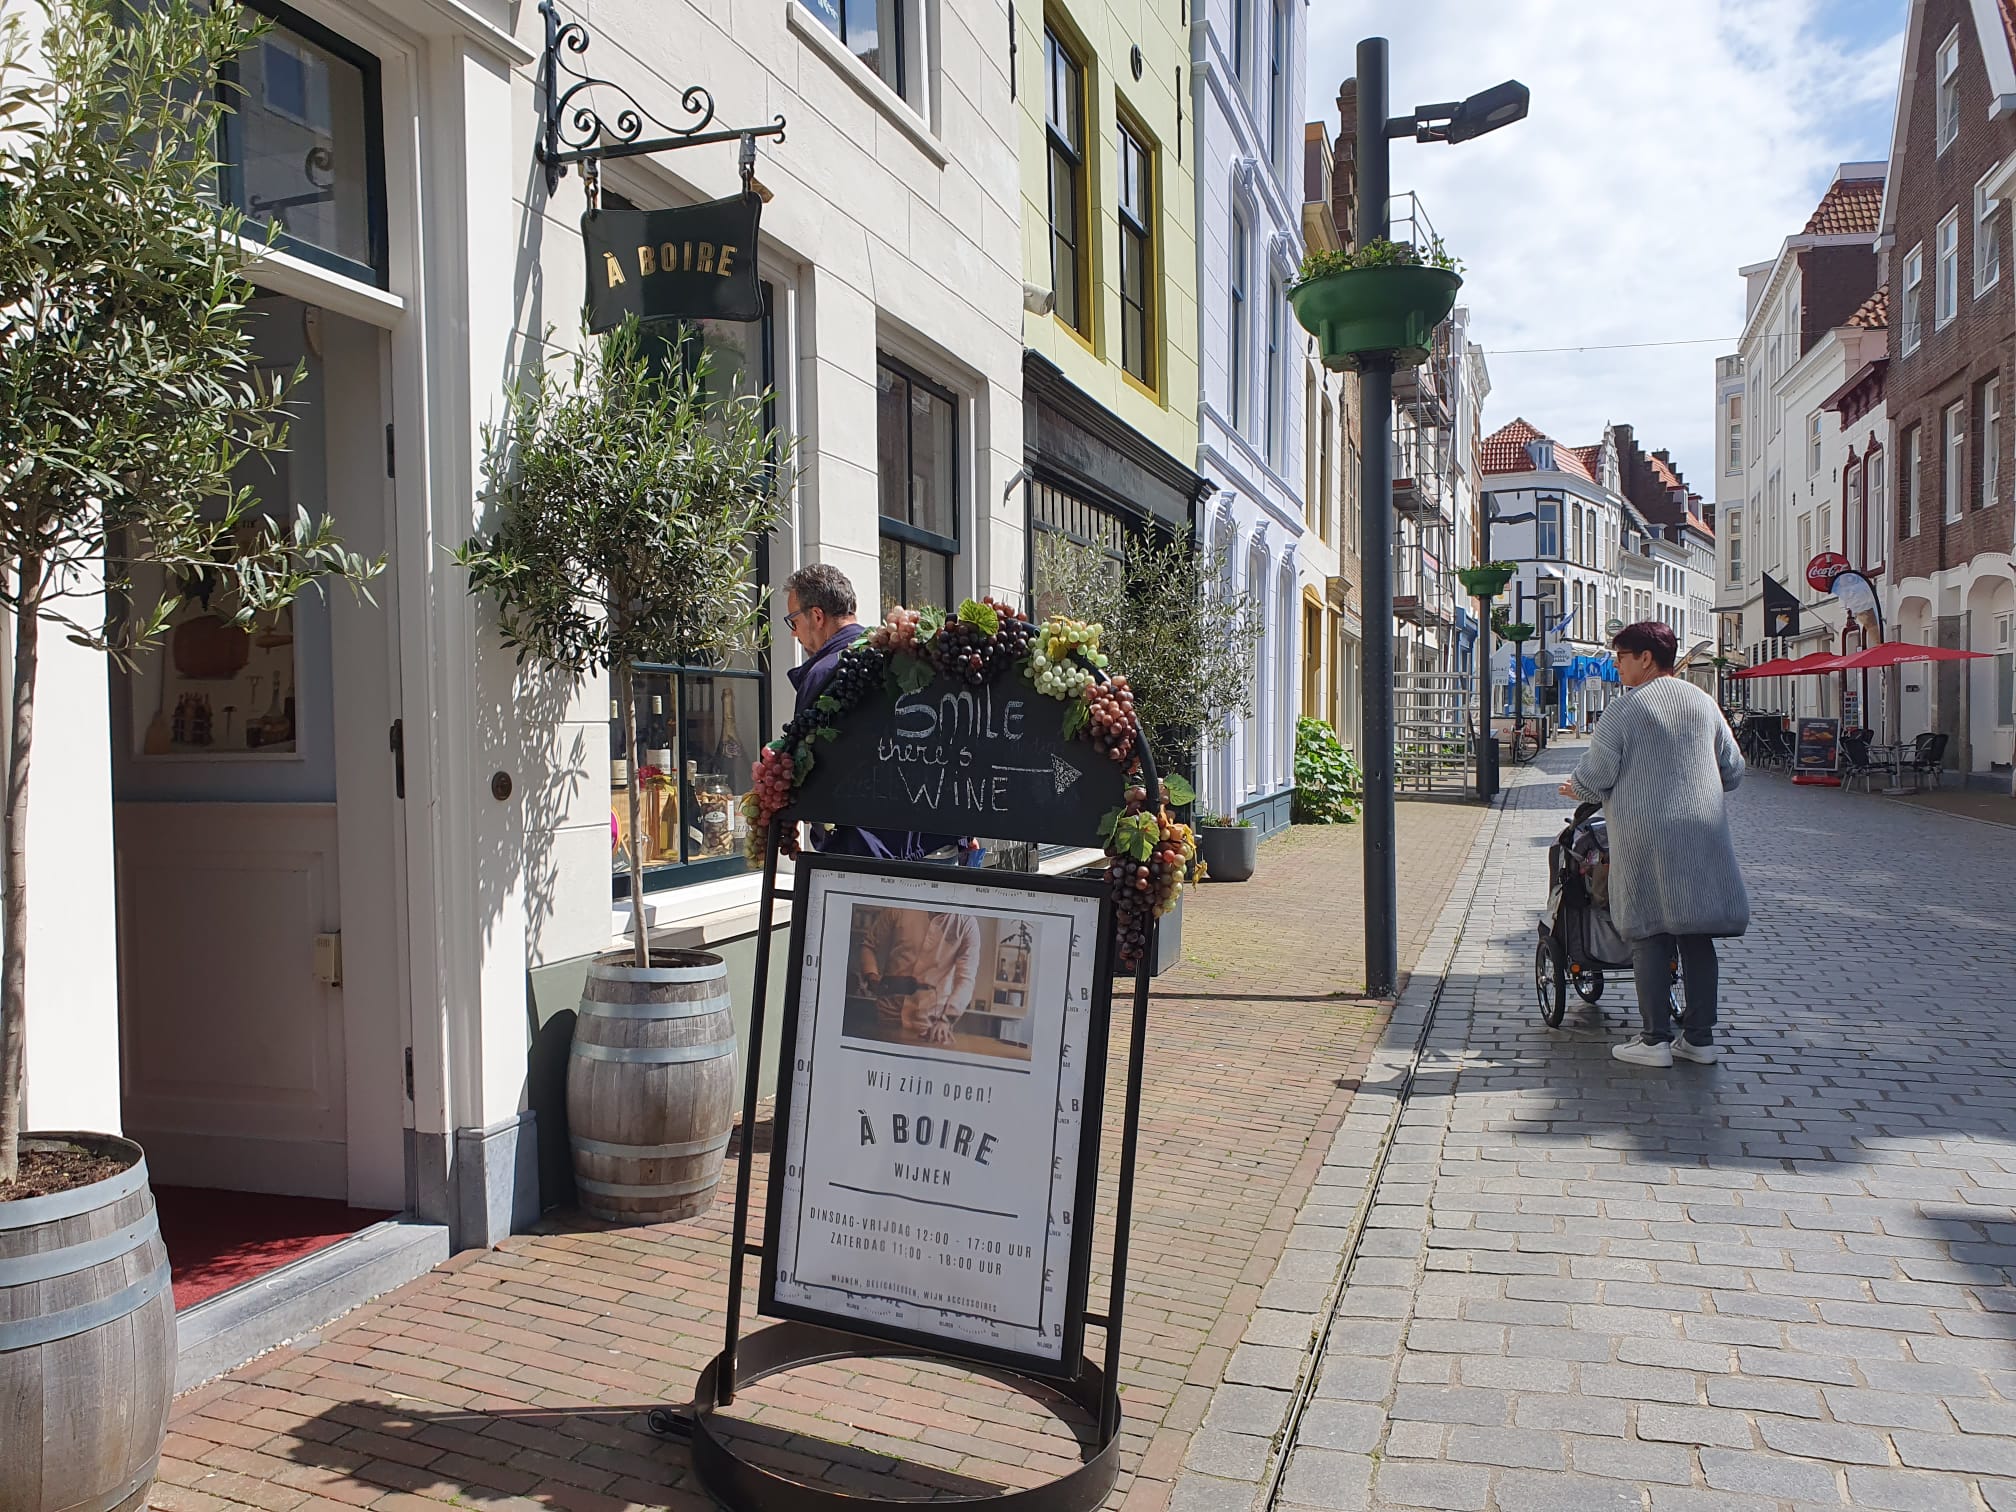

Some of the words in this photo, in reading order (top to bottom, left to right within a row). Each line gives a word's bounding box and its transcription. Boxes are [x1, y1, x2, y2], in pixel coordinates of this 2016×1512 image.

[602, 251, 627, 288] À
[637, 241, 738, 277] BOIRE
[877, 737, 973, 767] there's
[867, 1069, 891, 1091] Wij
[900, 1075, 933, 1095] zijn
[943, 1082, 992, 1103] open!
[858, 1108, 876, 1146] À
[892, 1113, 999, 1166] BOIRE
[894, 1162, 951, 1186] WIJNEN
[810, 1206, 911, 1237] DINSDAG-VRIJDAG
[917, 1227, 949, 1245] 12:00
[967, 1237, 1001, 1254] 17:00
[1008, 1243, 1032, 1259] UUR
[830, 1231, 886, 1252] ZATERDAG
[893, 1241, 921, 1260] 11:00
[939, 1253, 972, 1270] 18:00
[979, 1259, 1002, 1275] UUR
[923, 1290, 943, 1301] WIJN
